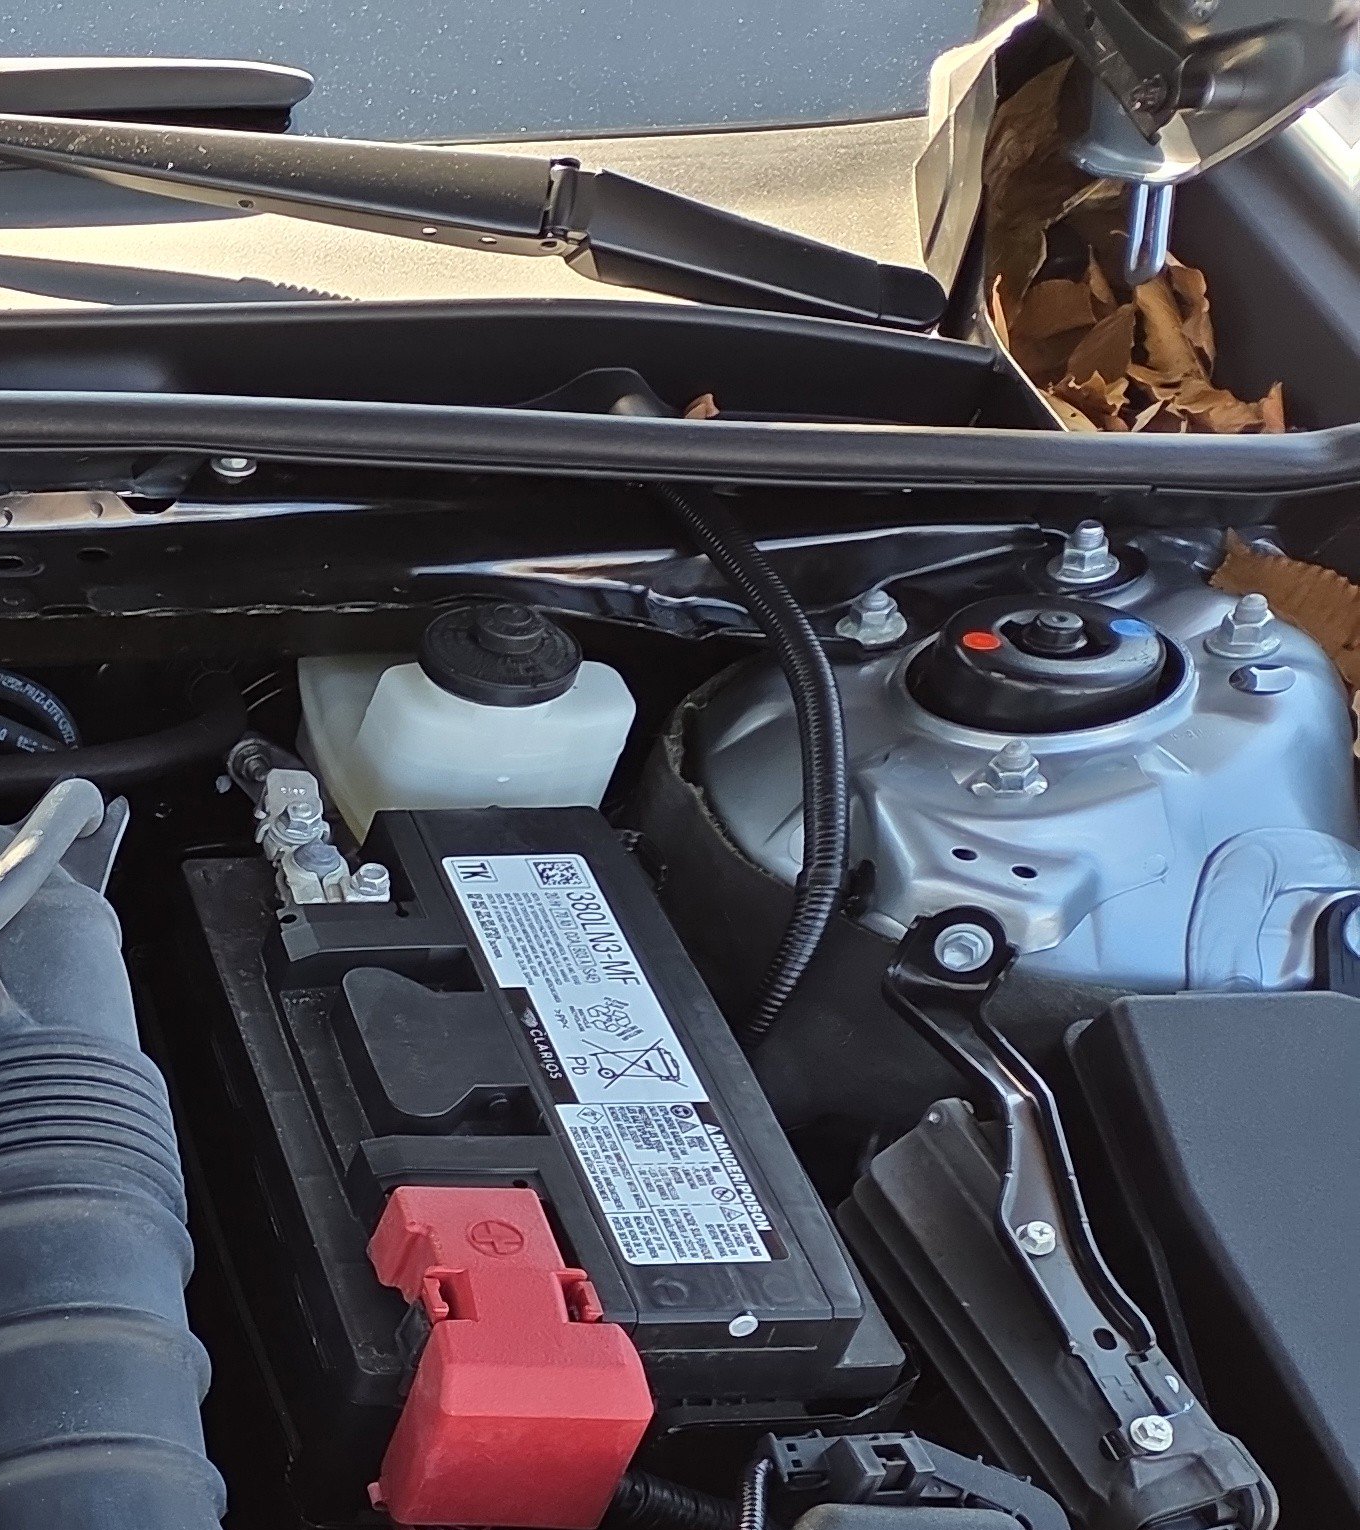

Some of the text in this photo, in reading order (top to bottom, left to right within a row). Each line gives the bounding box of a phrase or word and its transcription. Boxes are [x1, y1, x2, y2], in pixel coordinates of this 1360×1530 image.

[457, 862, 491, 879] TK
[566, 892, 641, 987] 380LN3-MF
[530, 1029, 562, 1080] CLARIOS
[566, 1056, 590, 1076] Pb
[707, 1132, 771, 1232] DANGER/POISON
